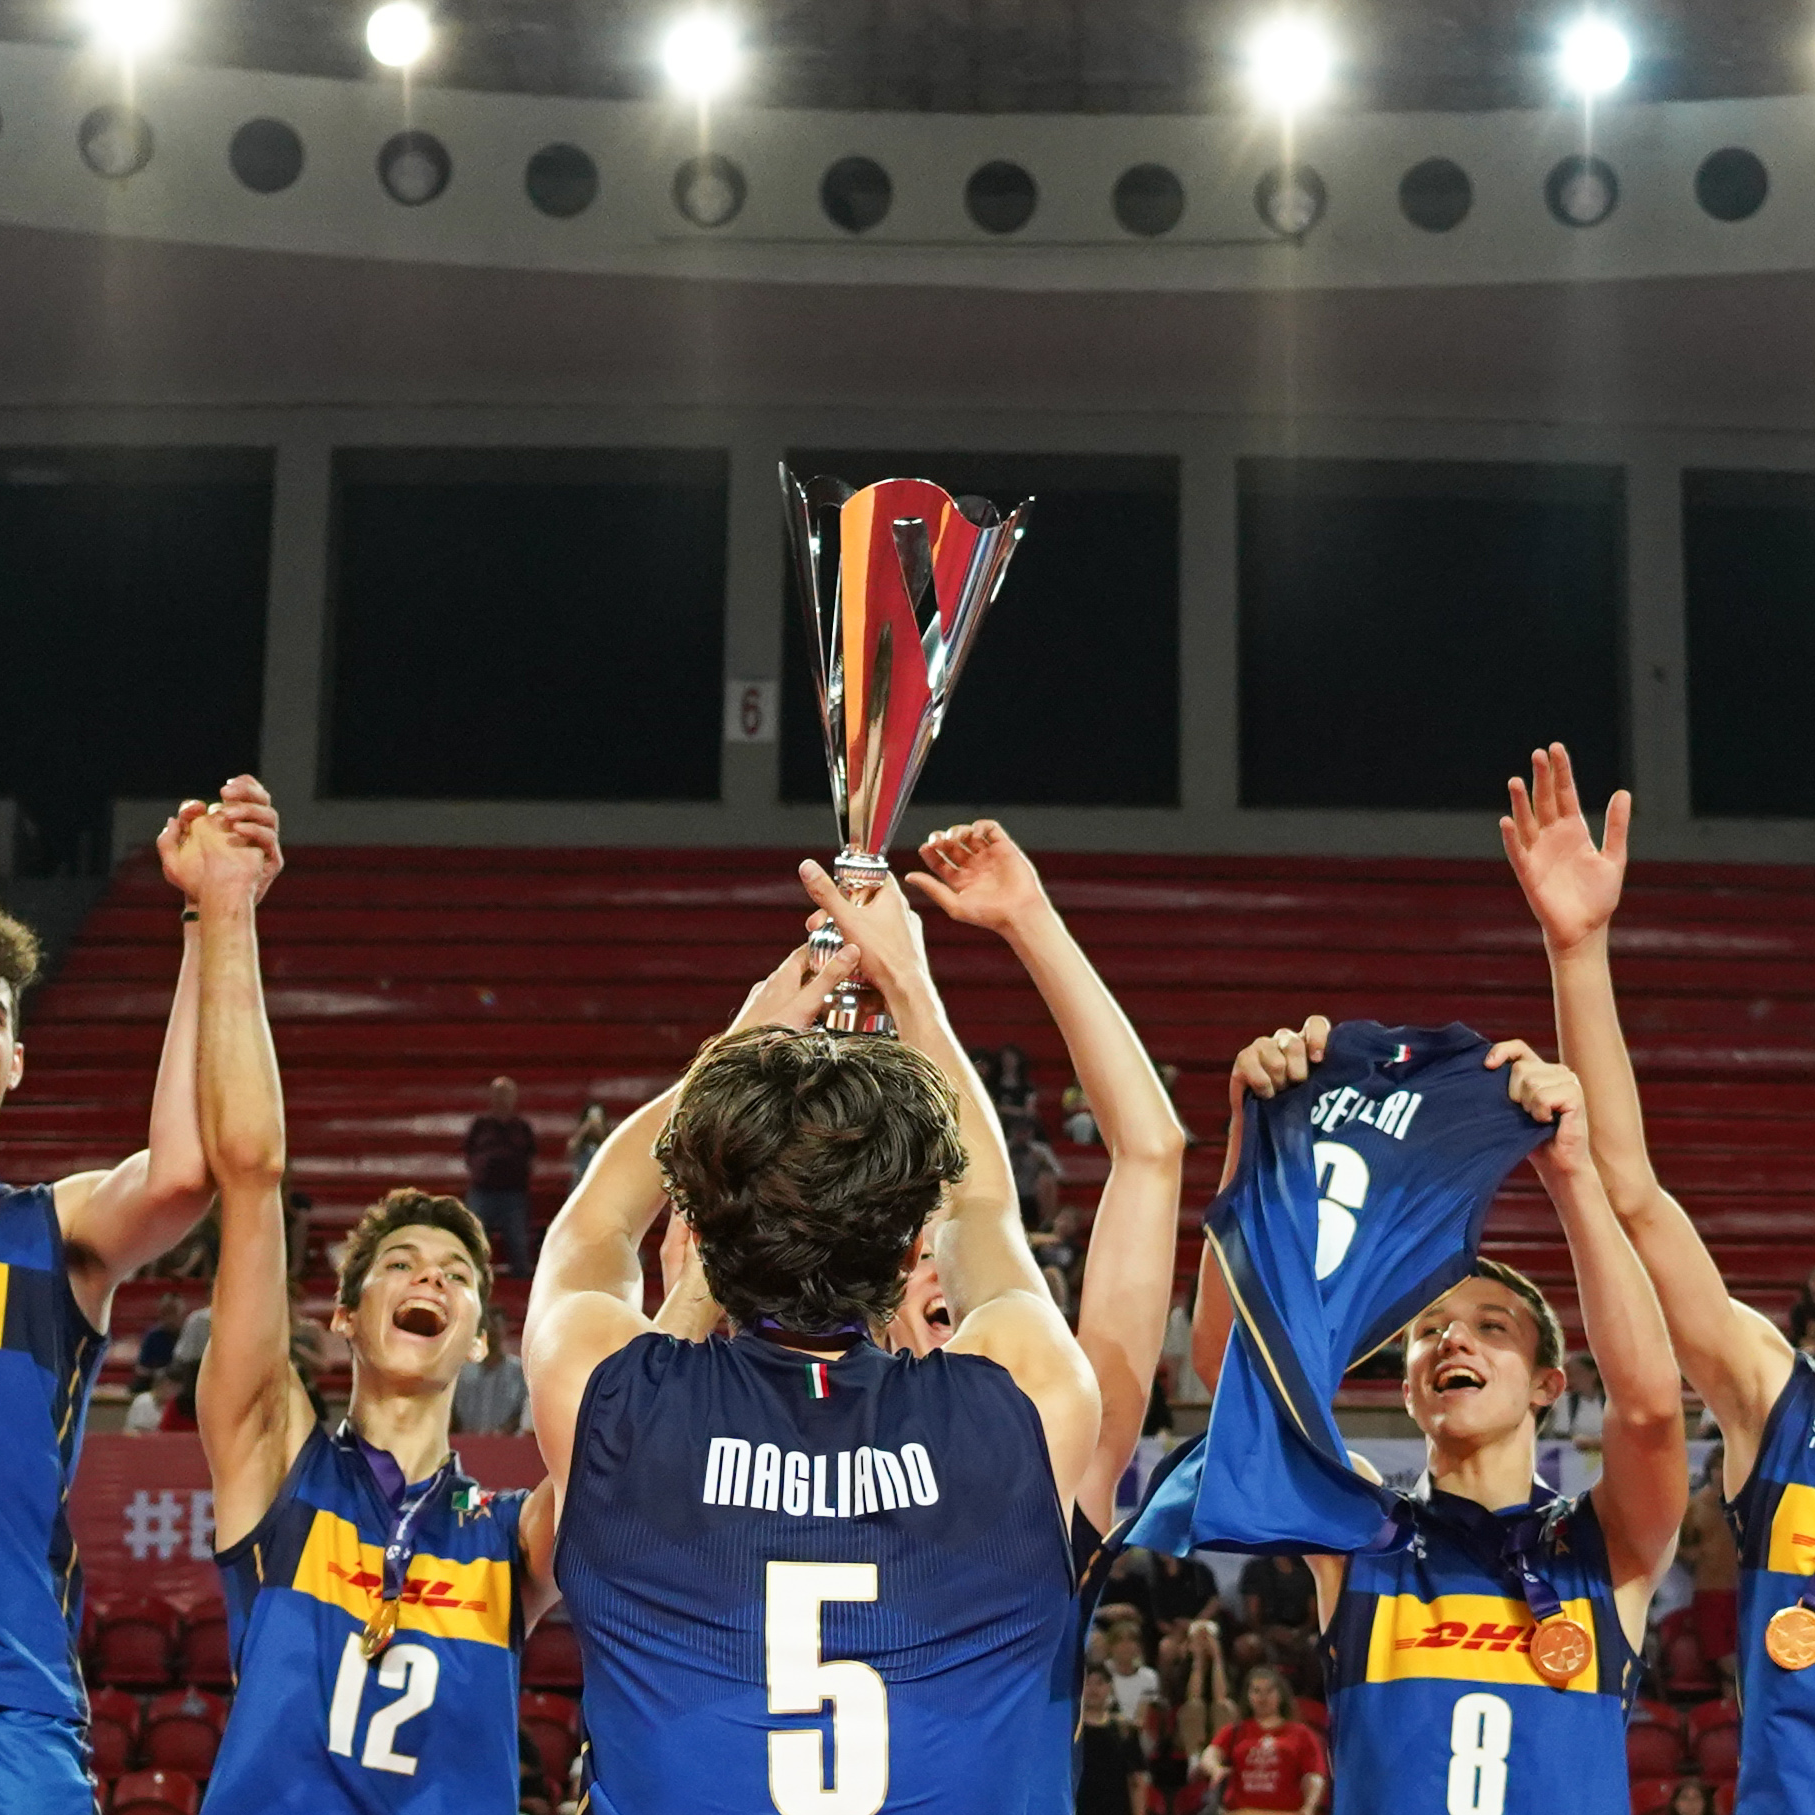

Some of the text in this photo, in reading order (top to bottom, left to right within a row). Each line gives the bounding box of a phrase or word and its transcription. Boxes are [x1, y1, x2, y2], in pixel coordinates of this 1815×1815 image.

[740, 688, 760, 737] 6
[702, 1436, 940, 1519] MAGLIANO
[328, 1631, 440, 1776] 12
